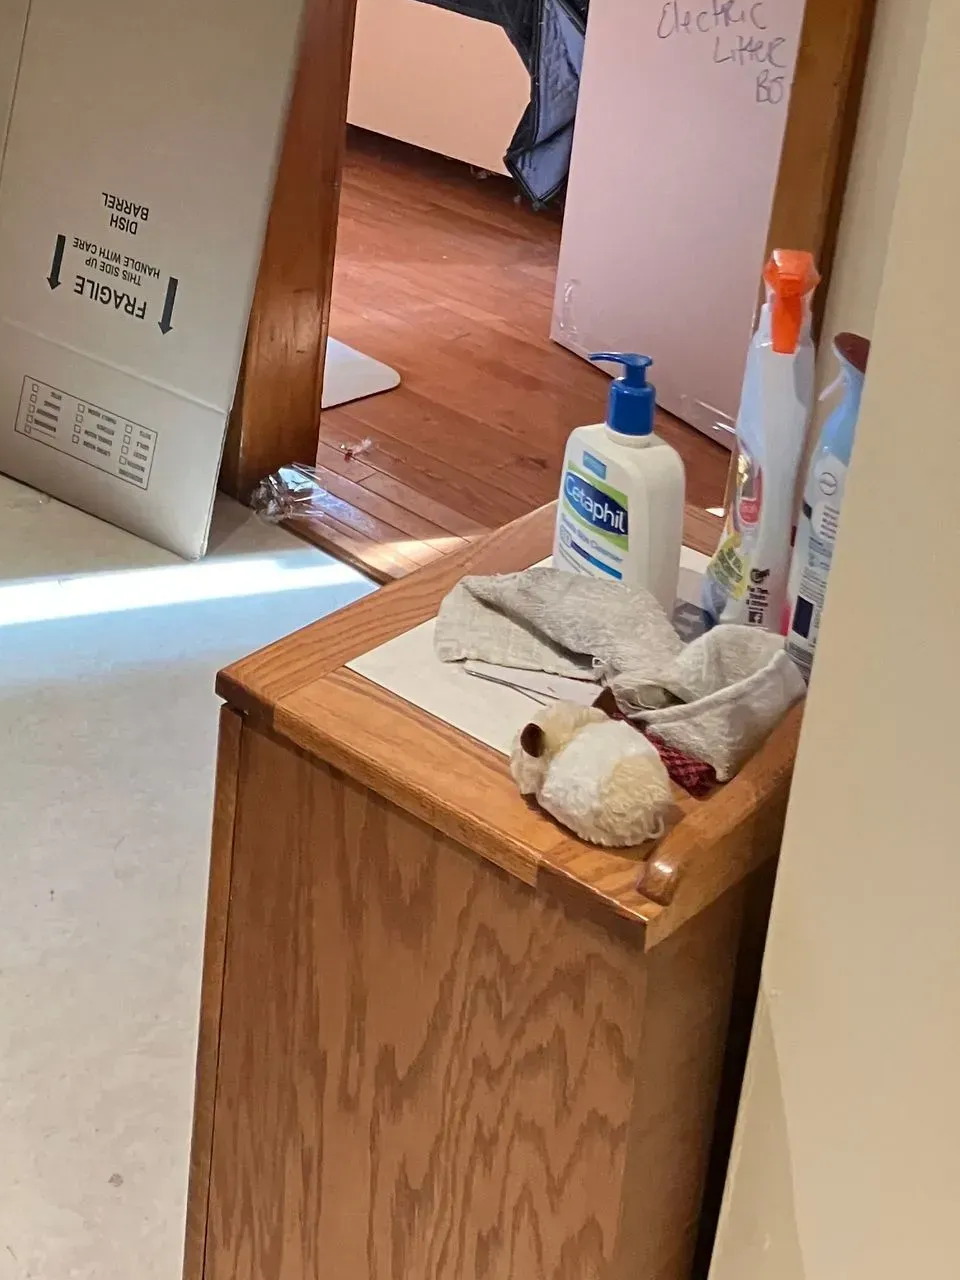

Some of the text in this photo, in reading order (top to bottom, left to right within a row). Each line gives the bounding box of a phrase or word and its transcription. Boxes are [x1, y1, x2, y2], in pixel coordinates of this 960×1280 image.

[101, 192, 150, 221] BARREL
[109, 213, 138, 235] DISH
[72, 237, 161, 279] HANDLE WITH CARE
[84, 257, 142, 287] THIS SIDE UP
[73, 275, 148, 320] FRAGILE
[565, 475, 628, 533] Cetaphil
